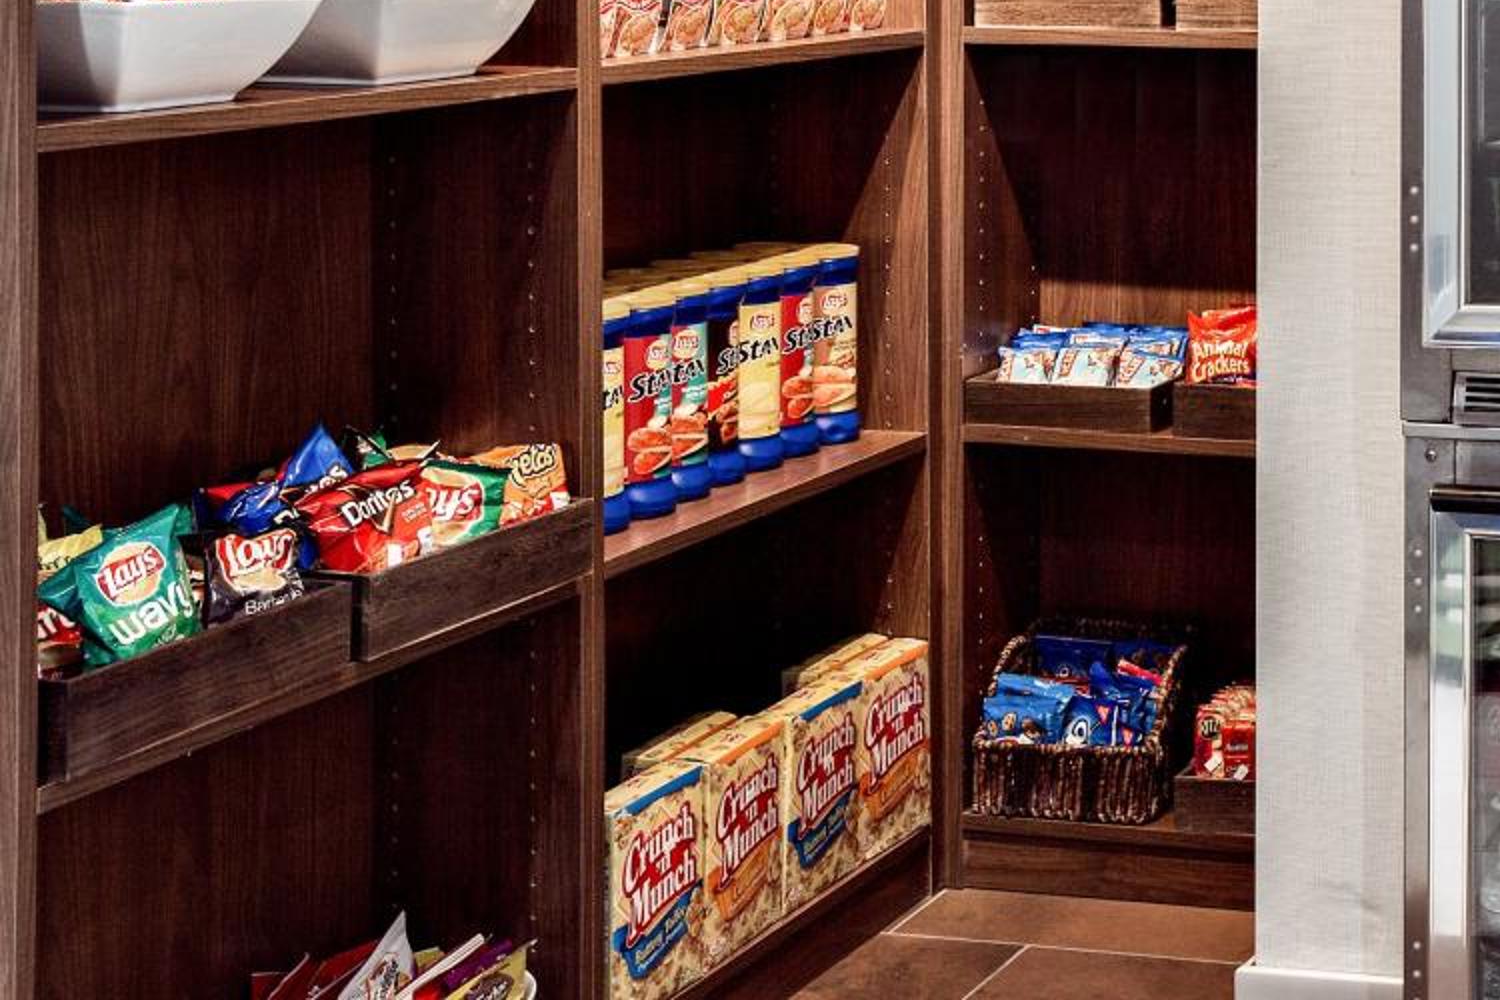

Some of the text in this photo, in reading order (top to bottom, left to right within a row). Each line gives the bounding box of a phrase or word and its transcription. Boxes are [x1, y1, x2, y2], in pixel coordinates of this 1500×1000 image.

[1190, 356, 1251, 383] Crackers
[1191, 340, 1248, 361] Animal
[340, 480, 416, 527] Doritos
[797, 712, 854, 798] Crunch
[866, 673, 924, 752] Crunch
[870, 713, 925, 787] Munch
[717, 753, 779, 846] Crunch
[799, 752, 854, 842] Munch
[622, 801, 695, 898] Crunch
[719, 797, 779, 892] Munch
[627, 853, 697, 950] Munch
